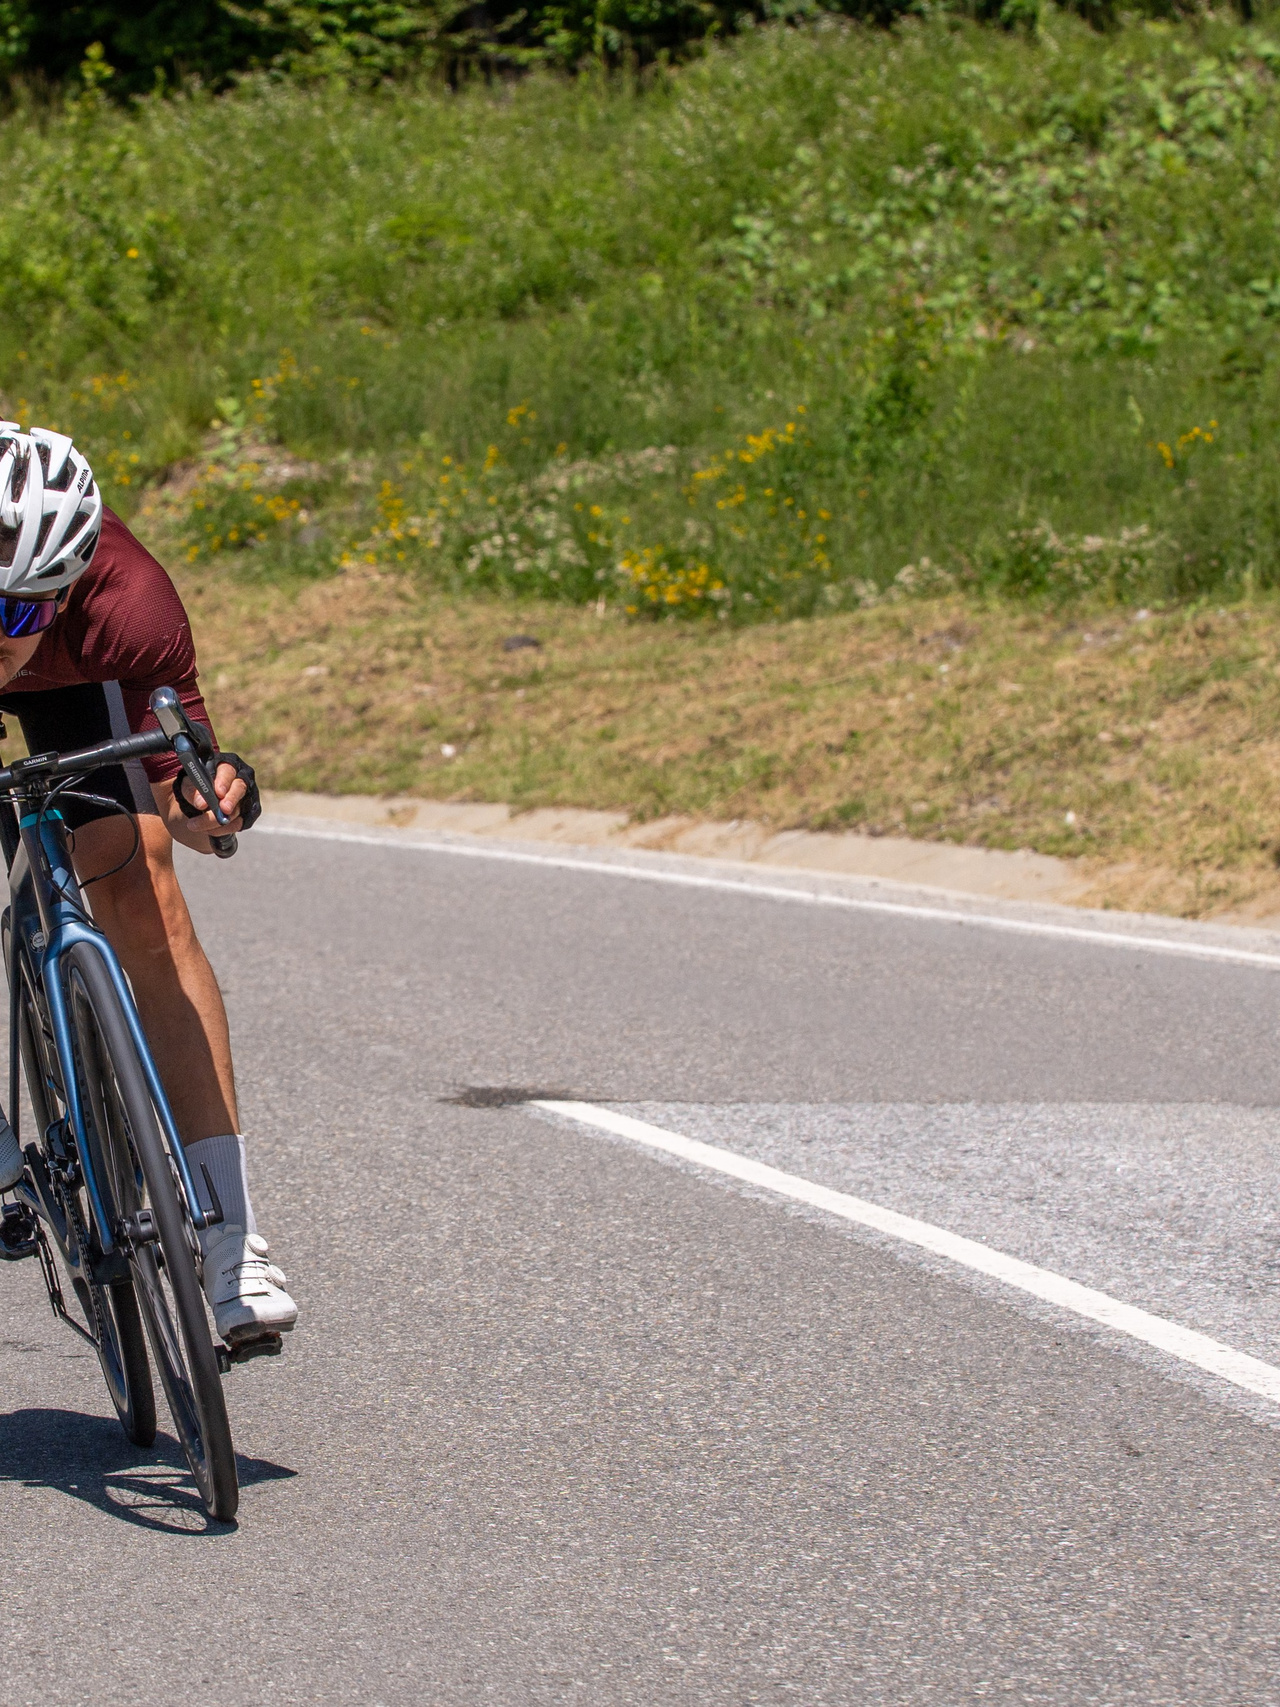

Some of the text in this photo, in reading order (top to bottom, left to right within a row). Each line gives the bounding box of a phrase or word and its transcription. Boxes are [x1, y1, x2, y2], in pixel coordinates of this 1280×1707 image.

[77, 468, 90, 494] ALPINA
[23, 756, 48, 766] GARMIN
[187, 761, 210, 794] SHIMANO
